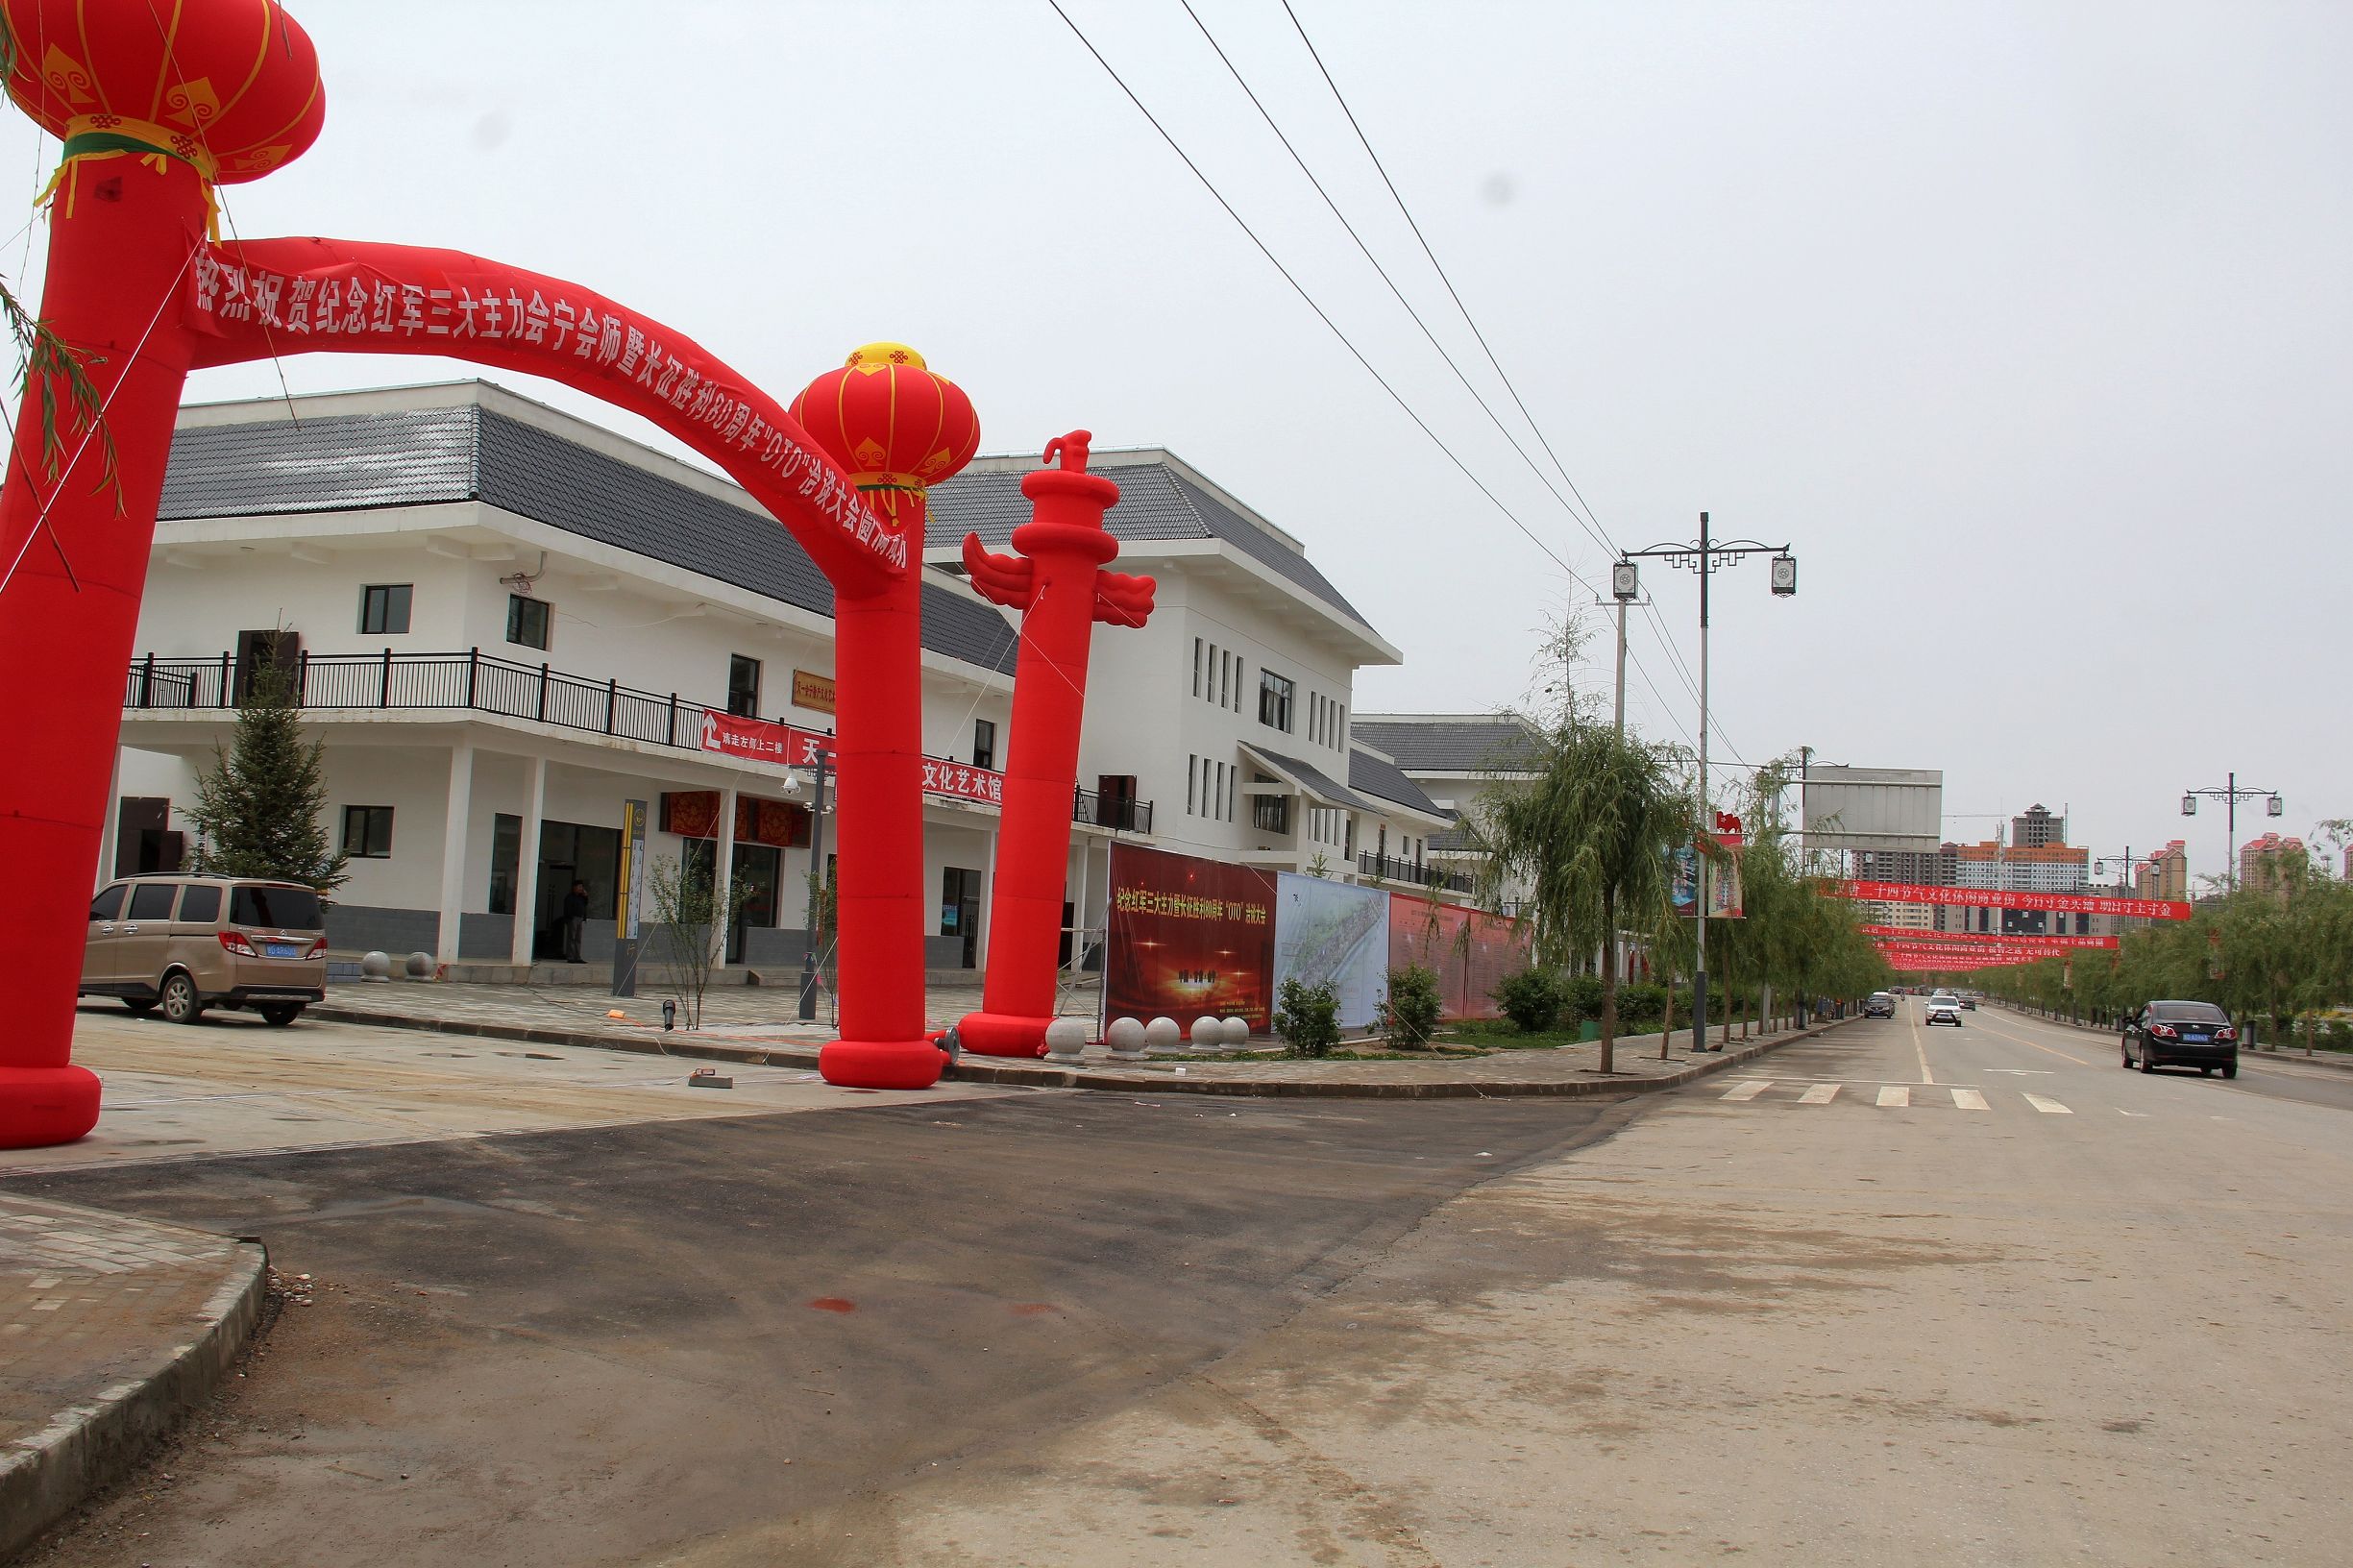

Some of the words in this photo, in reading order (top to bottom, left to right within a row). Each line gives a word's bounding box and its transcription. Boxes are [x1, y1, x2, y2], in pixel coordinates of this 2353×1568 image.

[723, 731, 784, 755] 请走左侧上二楼
[922, 762, 1002, 800] 文化艺术馆
